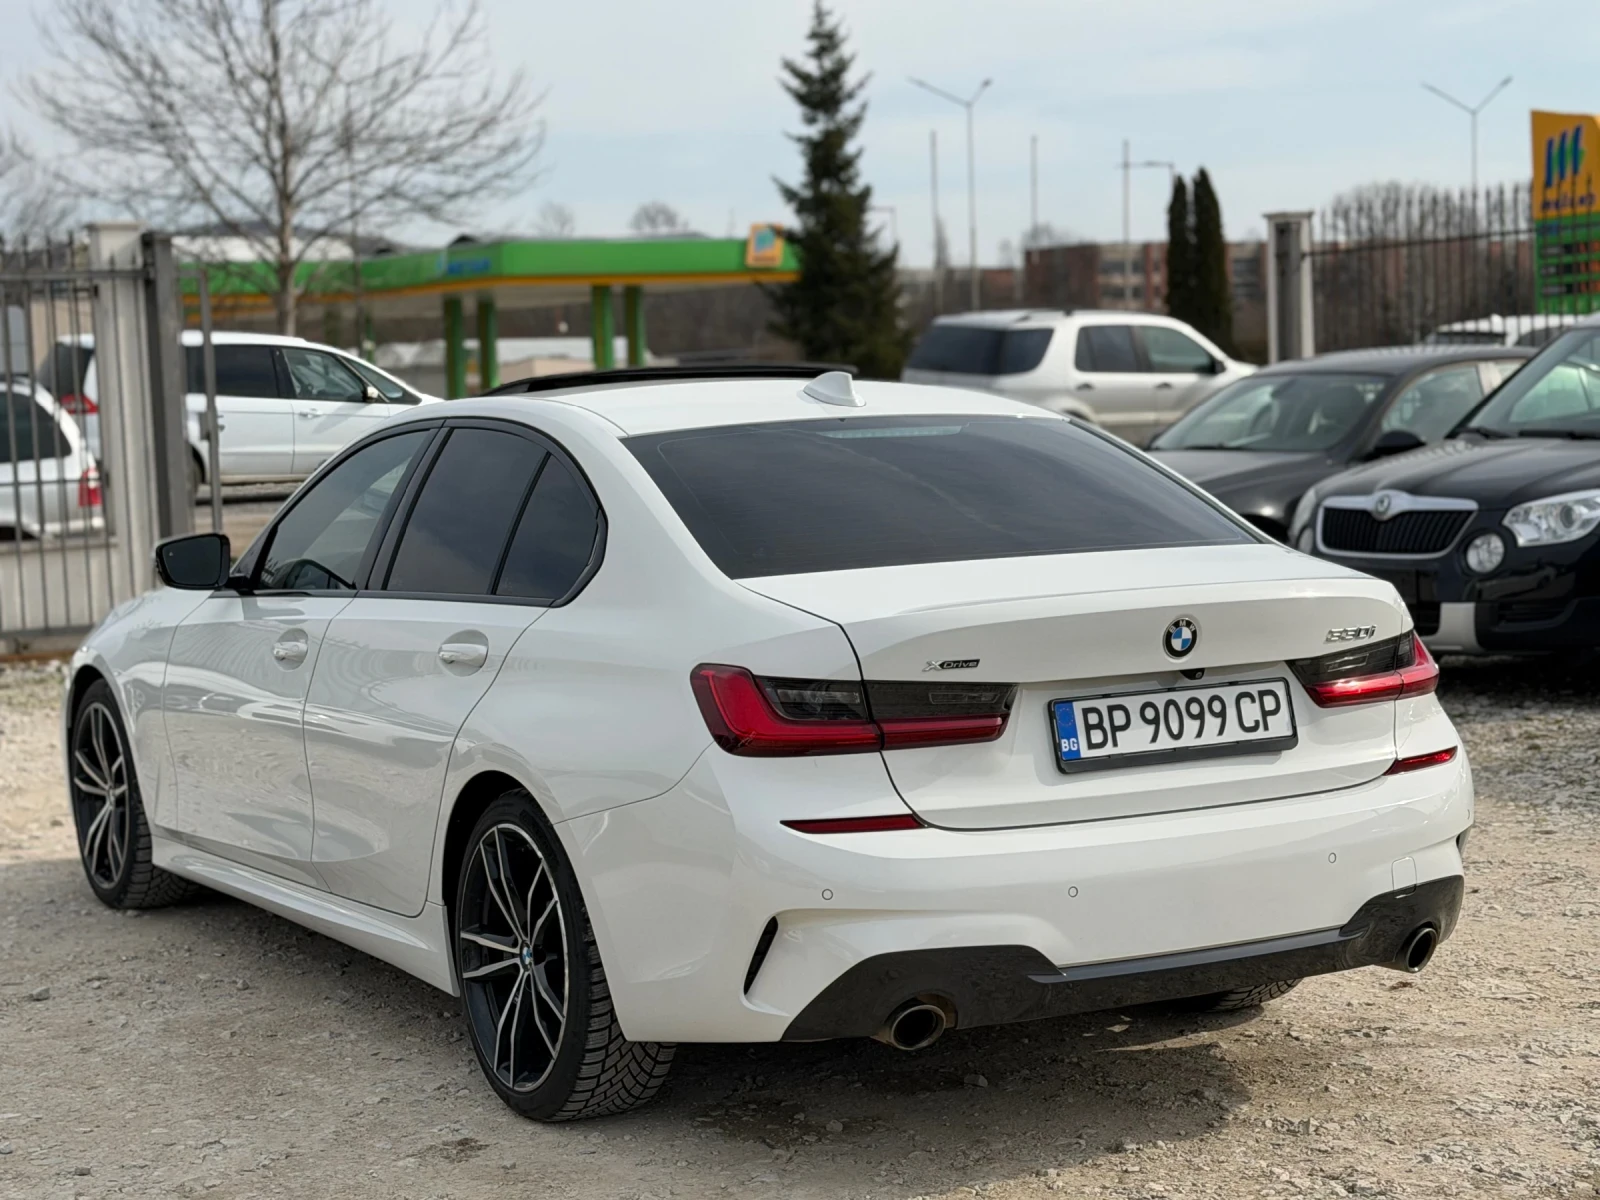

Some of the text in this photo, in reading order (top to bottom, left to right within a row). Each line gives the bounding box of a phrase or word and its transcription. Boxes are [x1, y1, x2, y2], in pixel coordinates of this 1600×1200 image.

[1324, 624, 1377, 643] 330i
[1081, 689, 1282, 751] BP 9099 CP
[1061, 738, 1078, 752] BG
